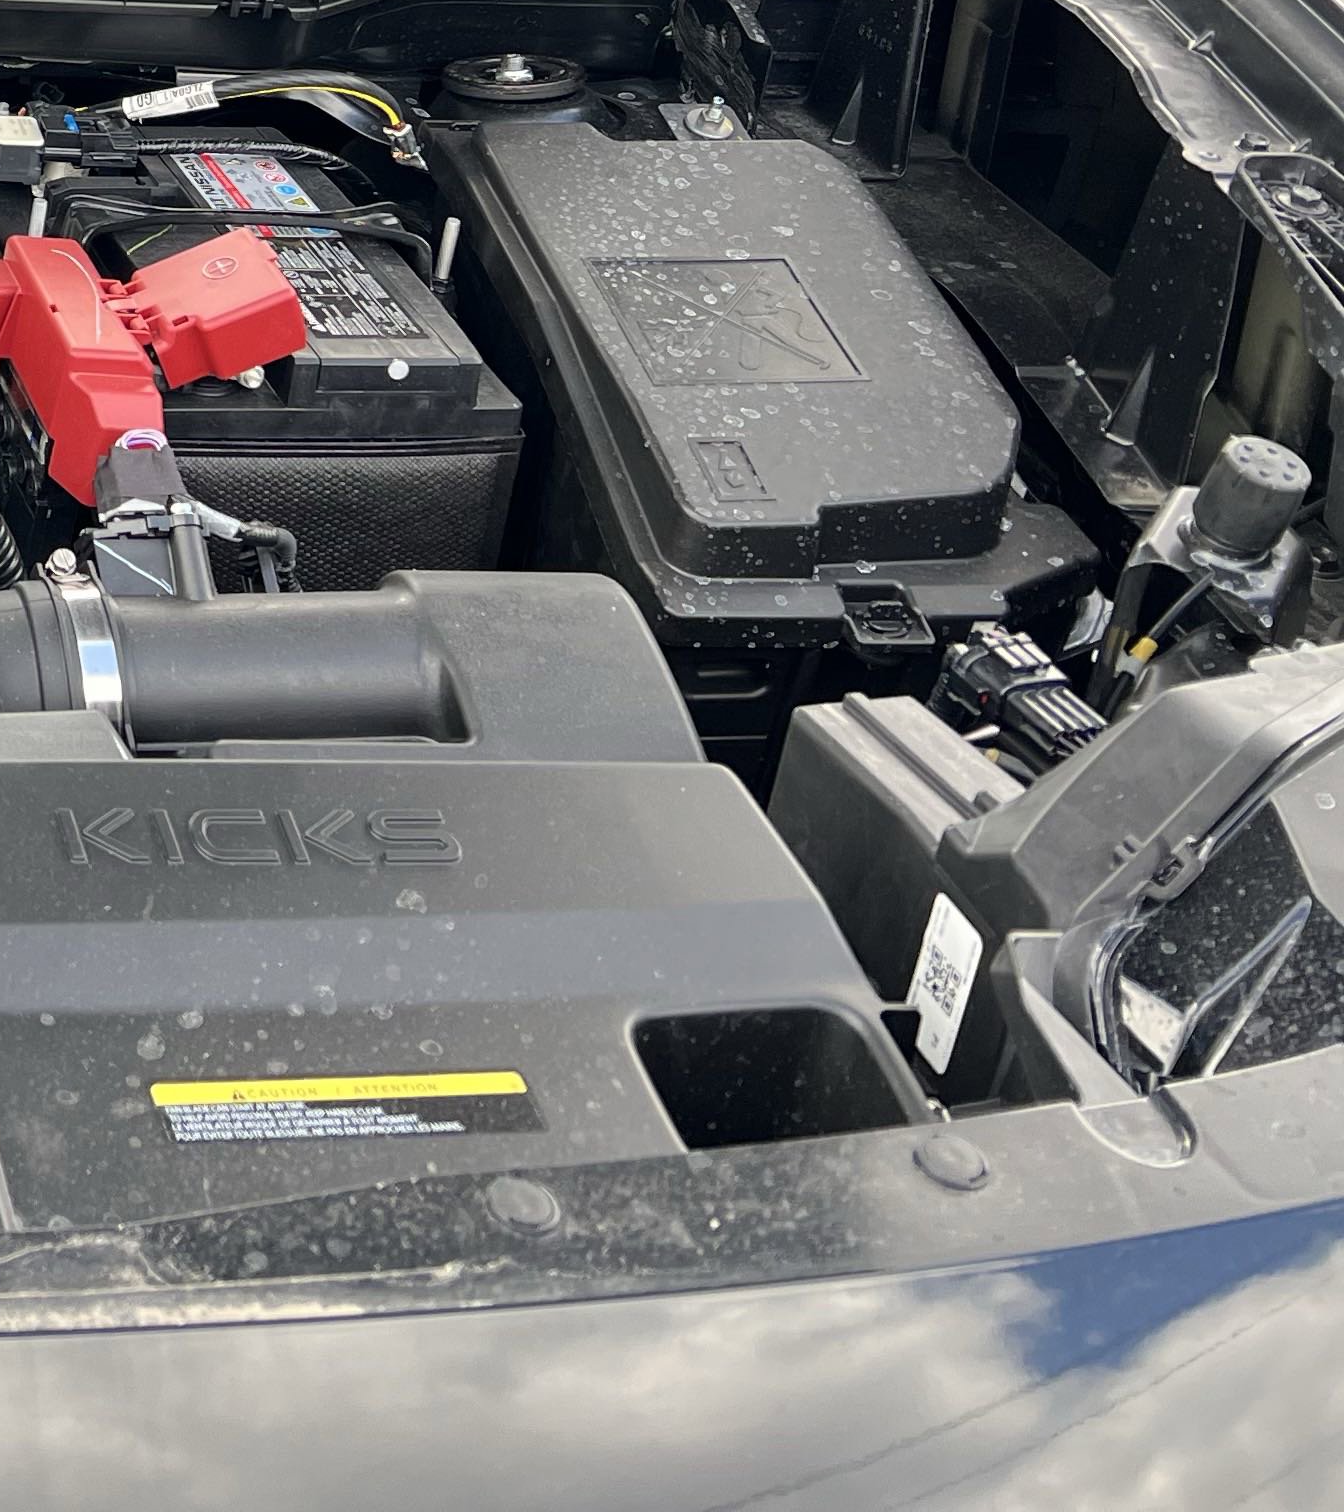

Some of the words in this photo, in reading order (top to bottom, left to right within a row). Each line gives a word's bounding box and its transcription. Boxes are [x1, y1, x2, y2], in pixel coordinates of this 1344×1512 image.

[54, 807, 464, 866] KICKS
[246, 1087, 318, 1099] CAUTION
[353, 1083, 438, 1095] ATTENTION
